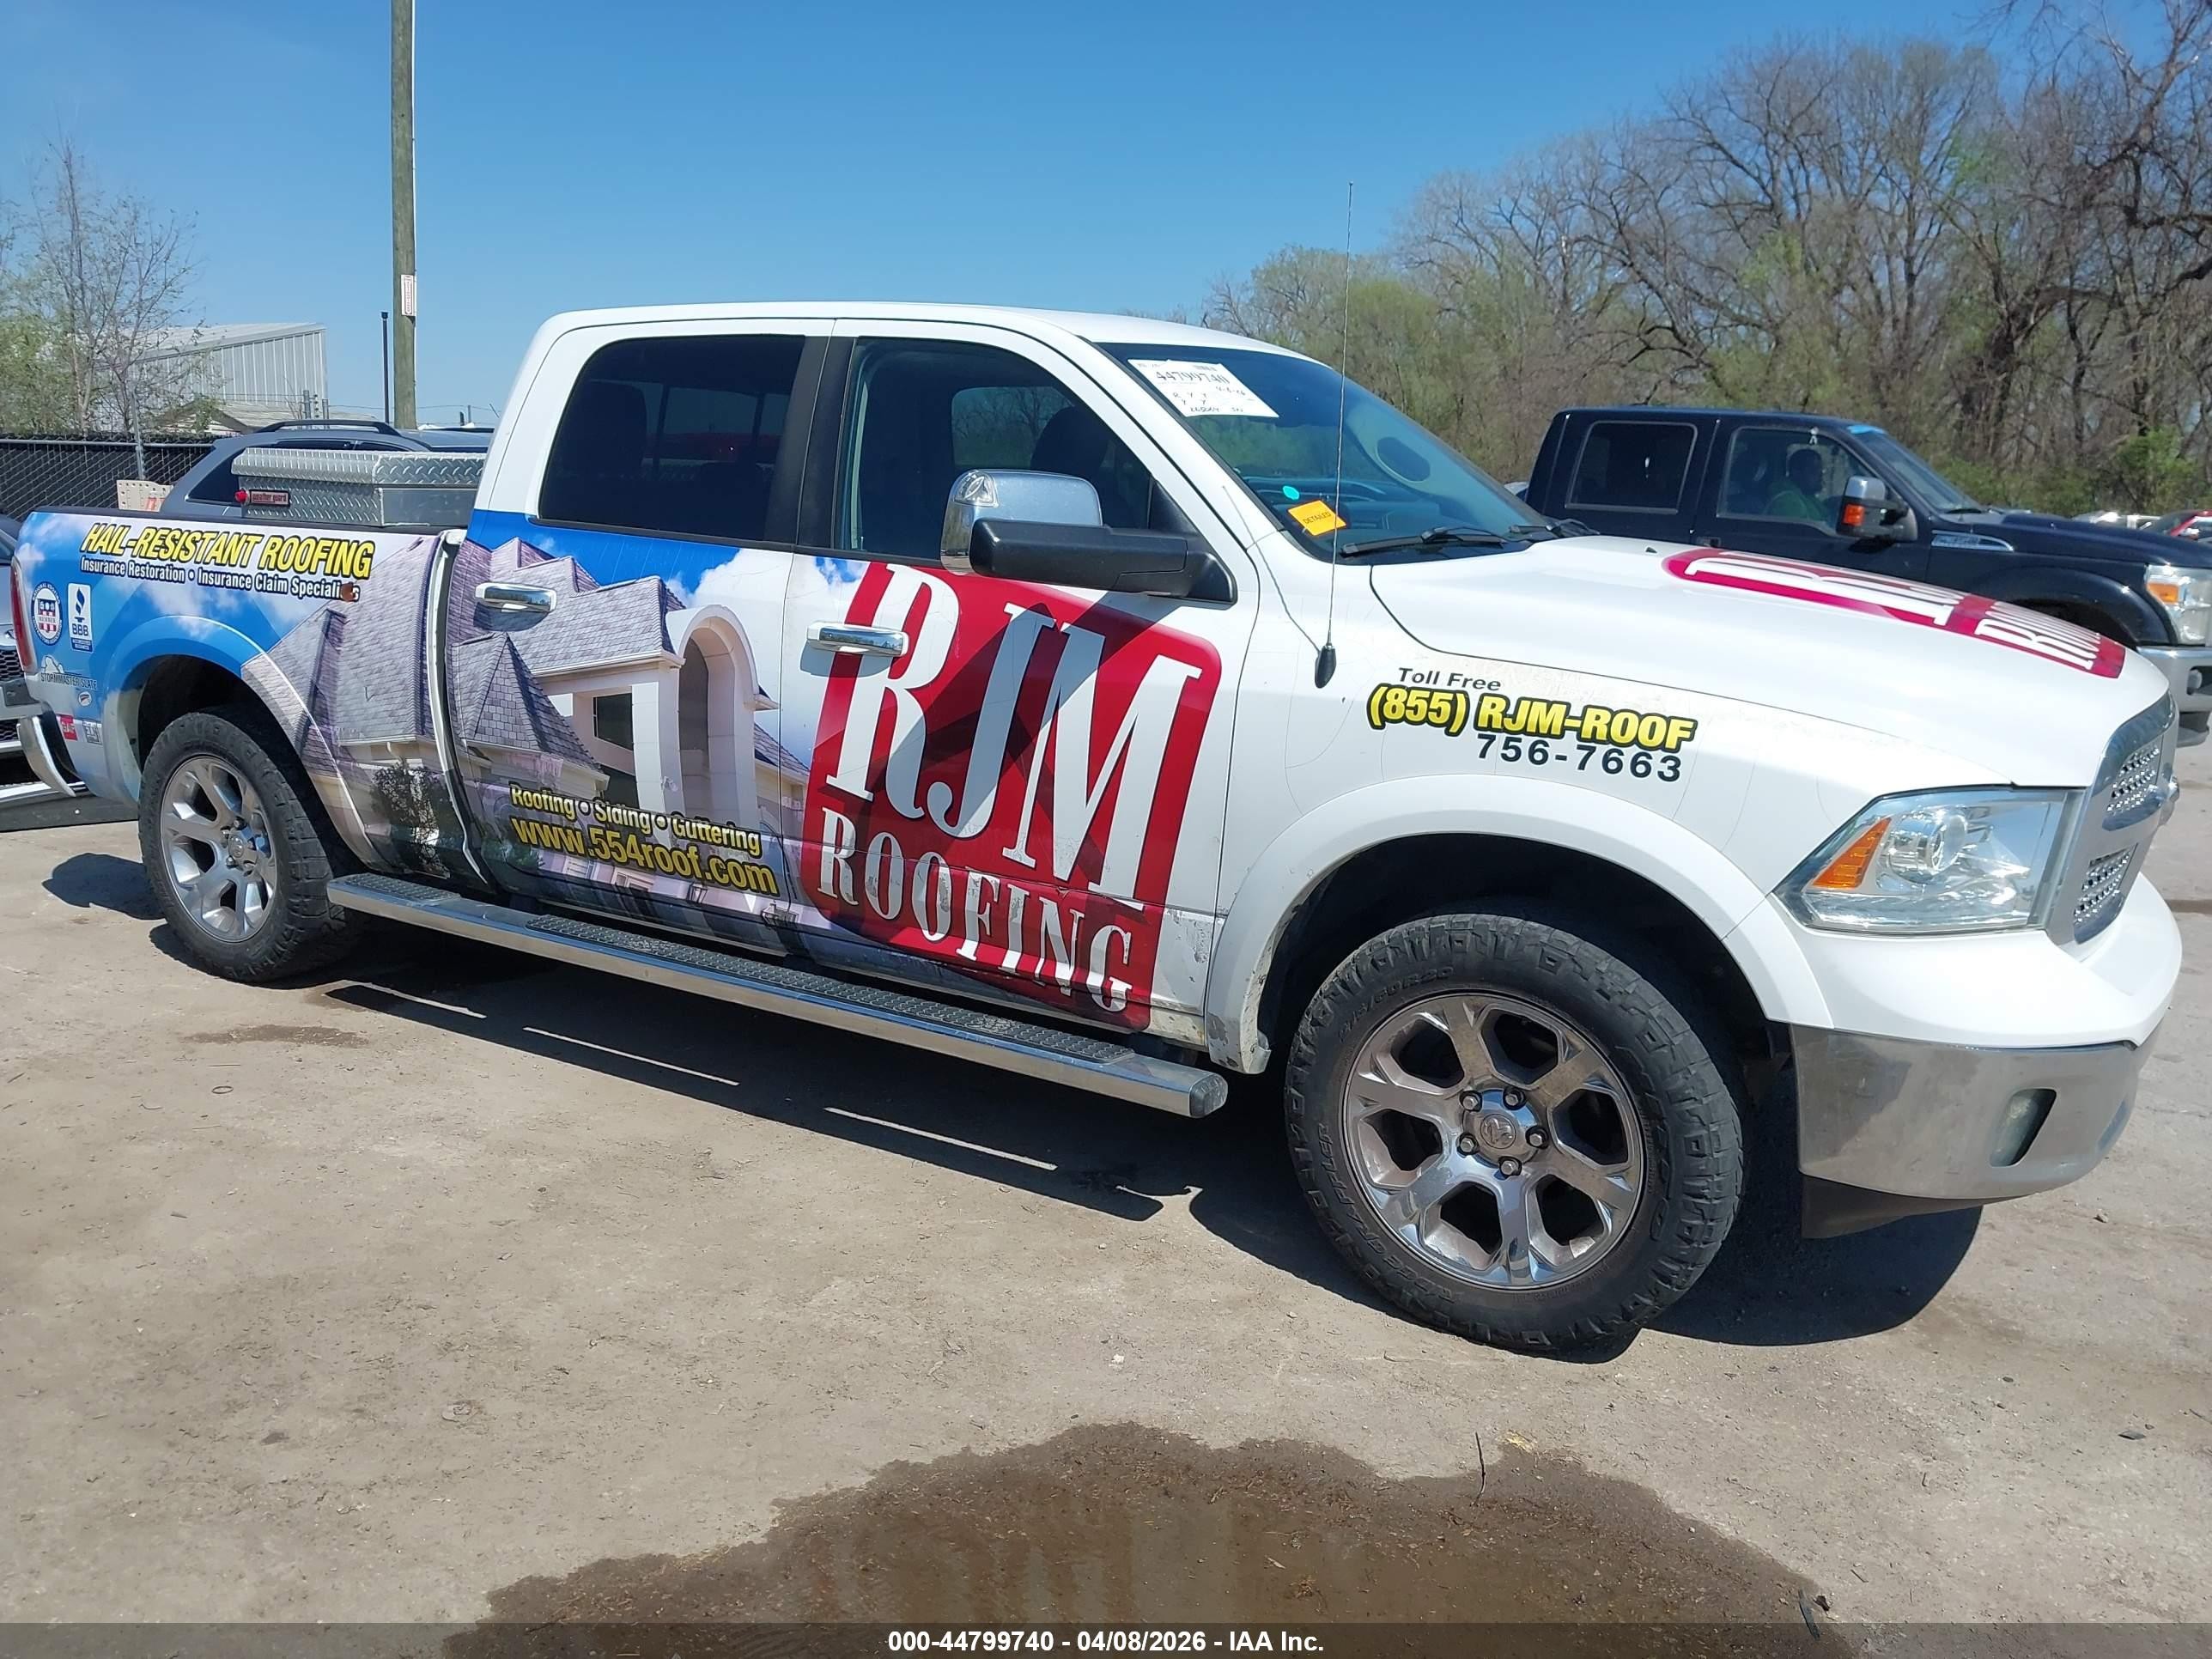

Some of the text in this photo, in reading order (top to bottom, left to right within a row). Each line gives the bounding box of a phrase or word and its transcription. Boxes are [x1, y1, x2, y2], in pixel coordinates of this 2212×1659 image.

[81, 523, 375, 580] HAIL-RESISTANT ROOFING
[81, 556, 361, 601] Insurance Restoration Insurance Claim Specialis
[72, 623, 88, 636] BBB
[1399, 667, 1502, 692] Toll Free
[825, 563, 1204, 911] RJM
[1367, 684, 1698, 752] (855) RJM-ROOF
[1476, 733, 1682, 782] 756-7663
[509, 783, 761, 856] Roofing Siding Guttering
[511, 818, 780, 897] www.554roof.com
[817, 805, 1133, 1013] ROOFING
